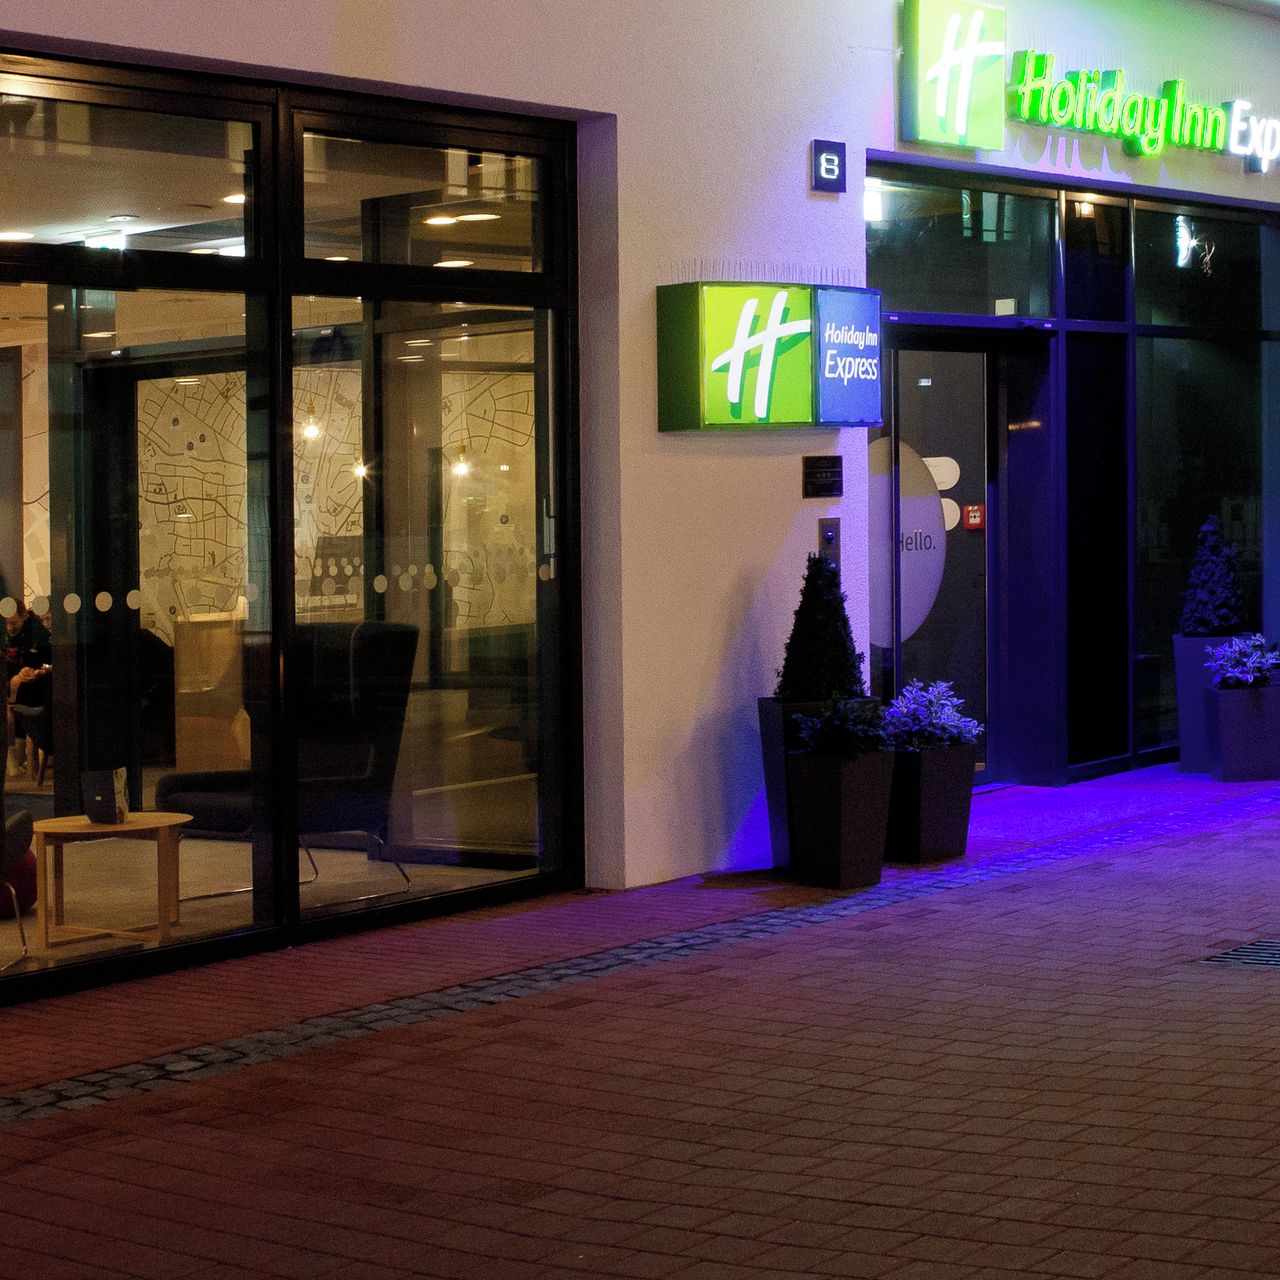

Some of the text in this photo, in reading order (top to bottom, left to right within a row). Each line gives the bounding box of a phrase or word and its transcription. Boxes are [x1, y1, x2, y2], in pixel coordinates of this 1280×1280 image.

[1016, 49, 1168, 156] Holiday
[1171, 78, 1227, 150] Inn
[824, 322, 878, 350] Holiday Inn
[824, 349, 878, 386] Express
